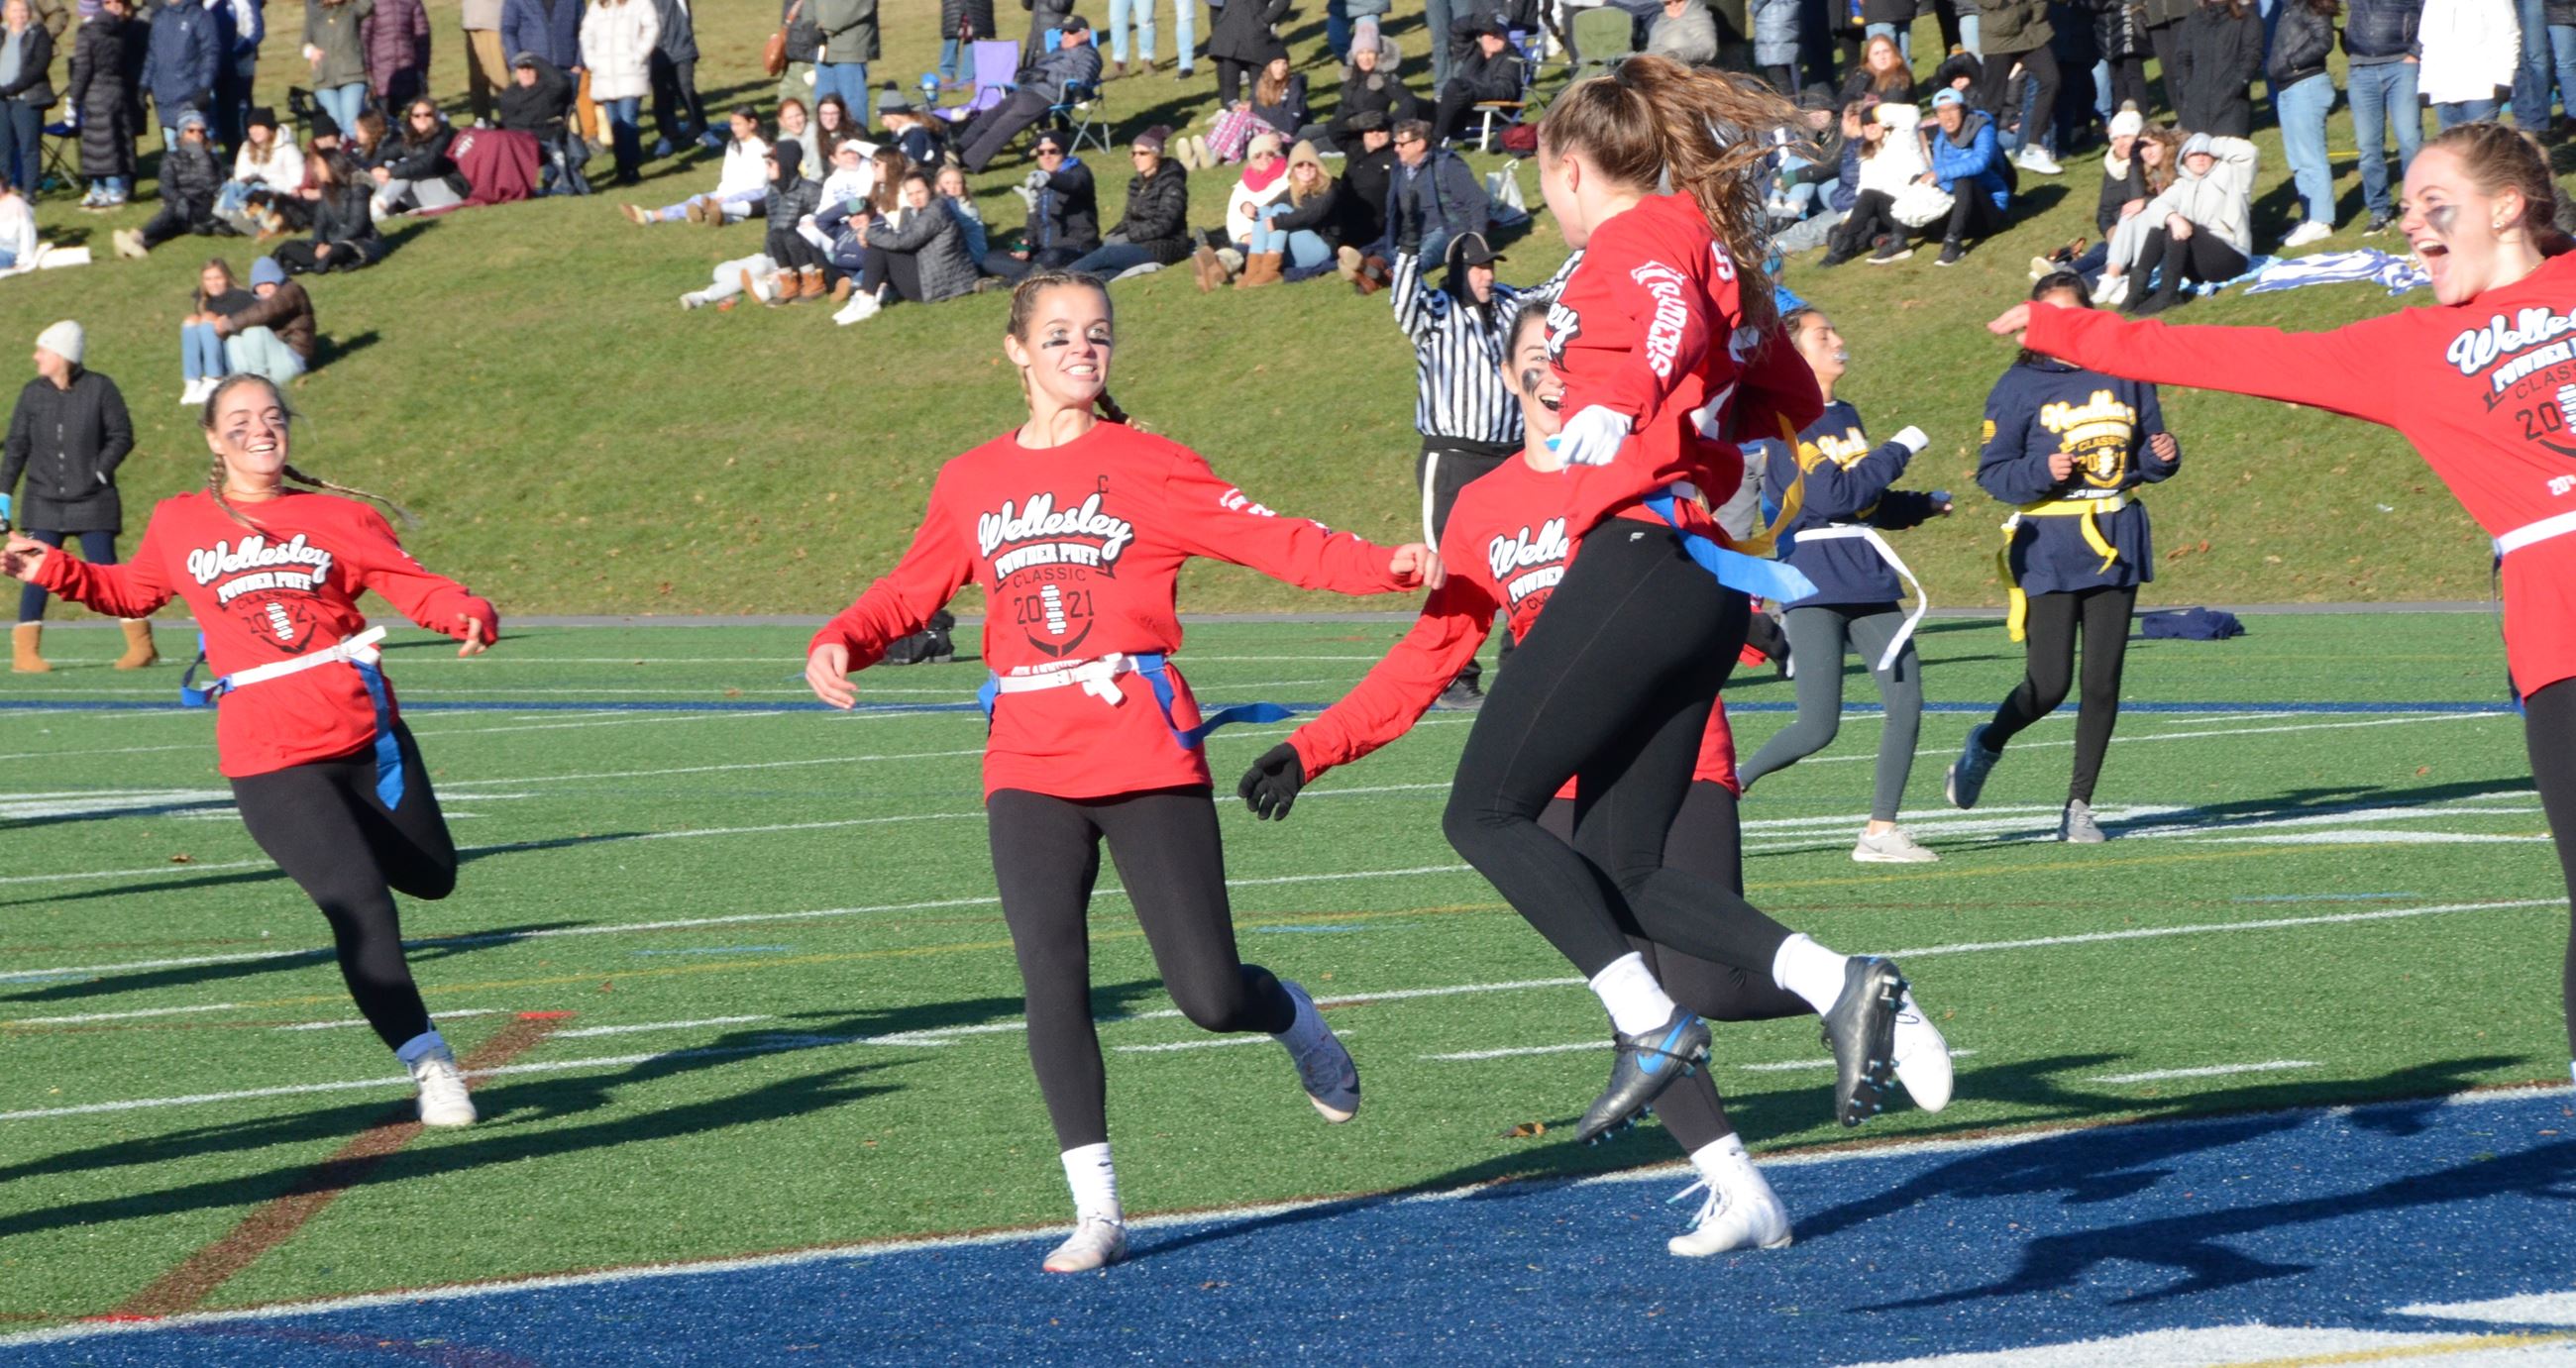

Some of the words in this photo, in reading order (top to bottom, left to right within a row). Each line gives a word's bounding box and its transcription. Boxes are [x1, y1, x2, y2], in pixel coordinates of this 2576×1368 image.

[2515, 365, 2576, 400] CLAS
[2515, 401, 2563, 441] 20
[1097, 474, 1109, 493] C
[978, 491, 1134, 562] Wellesley
[186, 533, 333, 585] Wellesley
[1058, 543, 1102, 567] PUFF
[273, 571, 312, 590] PUFF
[1013, 568, 1087, 587] CLASSIC
